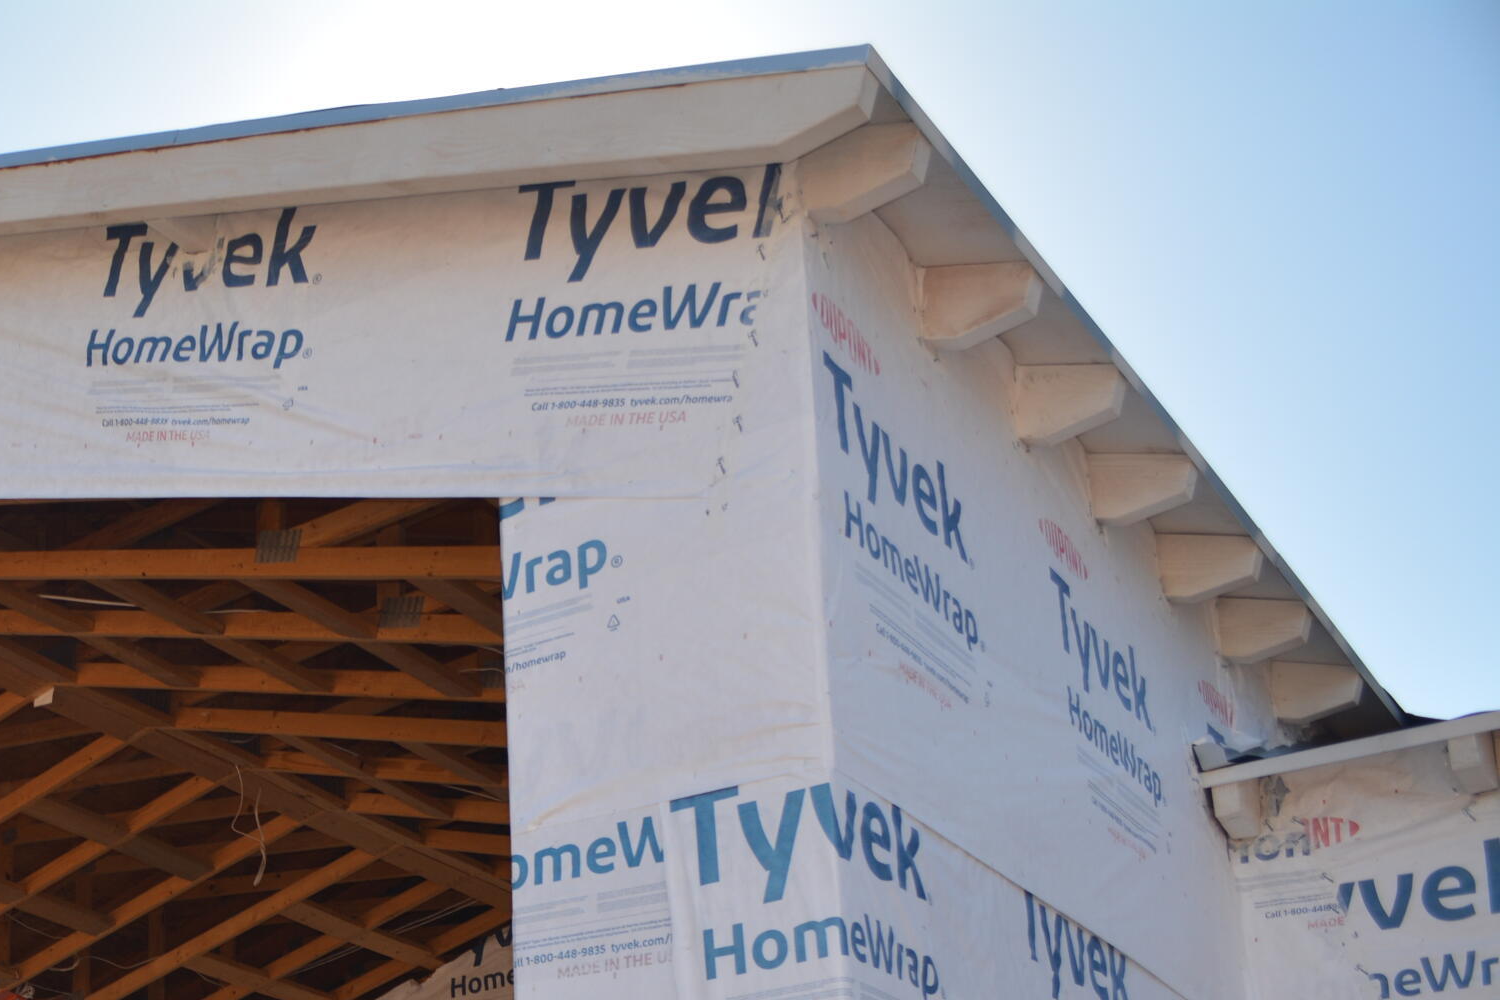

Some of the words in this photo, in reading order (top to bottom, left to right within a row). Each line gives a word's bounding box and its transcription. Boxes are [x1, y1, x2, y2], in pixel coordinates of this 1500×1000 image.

[86, 322, 304, 369] HomeWrap
[532, 402, 548, 411] Call
[551, 398, 625, 410] 1-800-448-9835
[630, 394, 732, 407] tyvek.com/homewra
[566, 413, 605, 428] MADE
[610, 413, 623, 425] IN
[628, 411, 653, 424] THE
[659, 410, 687, 423] USA
[156, 431, 167, 441] IN
[169, 430, 188, 441] THE
[823, 350, 968, 565] Tyvek
[843, 491, 979, 651] HomeWrap
[1049, 566, 1153, 733] Tyvek
[1068, 686, 1162, 815] HomeWrap
[669, 782, 927, 904] Tyvek
[526, 943, 606, 966] 1-800-448-9835
[604, 959, 620, 972] IN
[624, 953, 652, 968] THE
[451, 968, 514, 998] Home
